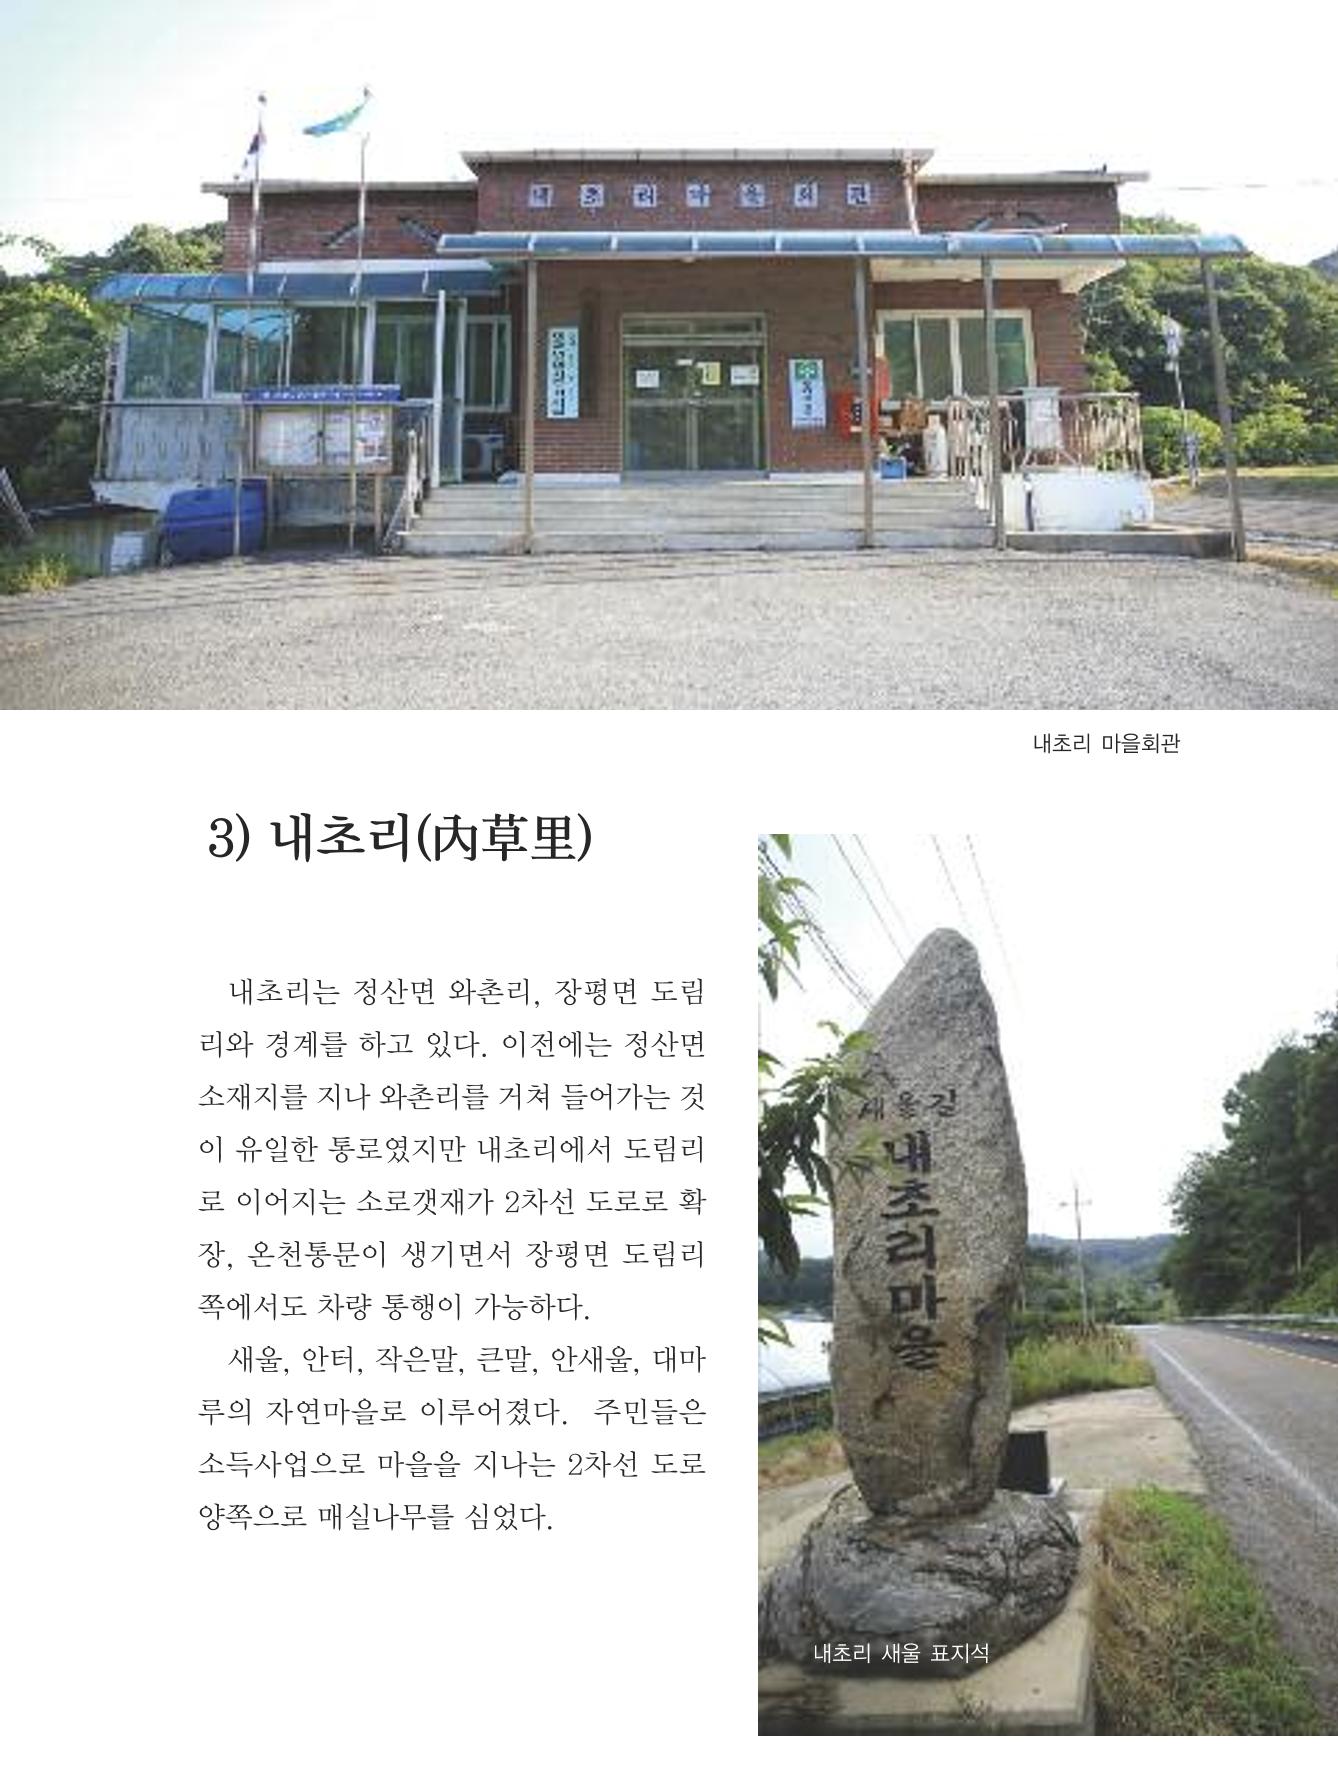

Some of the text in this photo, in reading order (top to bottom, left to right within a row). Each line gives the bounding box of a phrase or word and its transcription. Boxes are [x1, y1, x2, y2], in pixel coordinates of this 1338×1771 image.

[1034, 733, 1181, 754] 내초리 마을회관
[208, 812, 592, 863] 3) 내초리(內草里)
[229, 977, 703, 1009] 내초리는 정산면 와촌리, 장평면 도림
[200, 1030, 705, 1059] 리와 경계를 하고 있다. 이전에는 정산면
[198, 1082, 705, 1111] 소재지를 지나 와촌리를 거쳐 들어가는 것
[199, 1135, 703, 1164] 이 유일한 통로였지만 내초리에서 도림리
[198, 1187, 707, 1216] 로 이어지는 소로갯재가 2차선 도로로 확
[198, 1240, 703, 1271] 장, 온천통문이 생기면서 장평면 도림리
[881, 1130, 947, 1370] 내초리마을
[198, 1292, 590, 1321] 쪽에서도 차량 통행이 가능하다.
[229, 1345, 707, 1376] 새울, 안터, 작은말, 큰말, 안새울, 대마
[198, 1397, 707, 1426] 루의 자연마을로 이루어졌다. 주민들은
[198, 1450, 706, 1479] 소득사업으로 마을을 지나는 2차선 도로
[199, 1502, 552, 1531] 양쪽으로 매실나무를 심었다.
